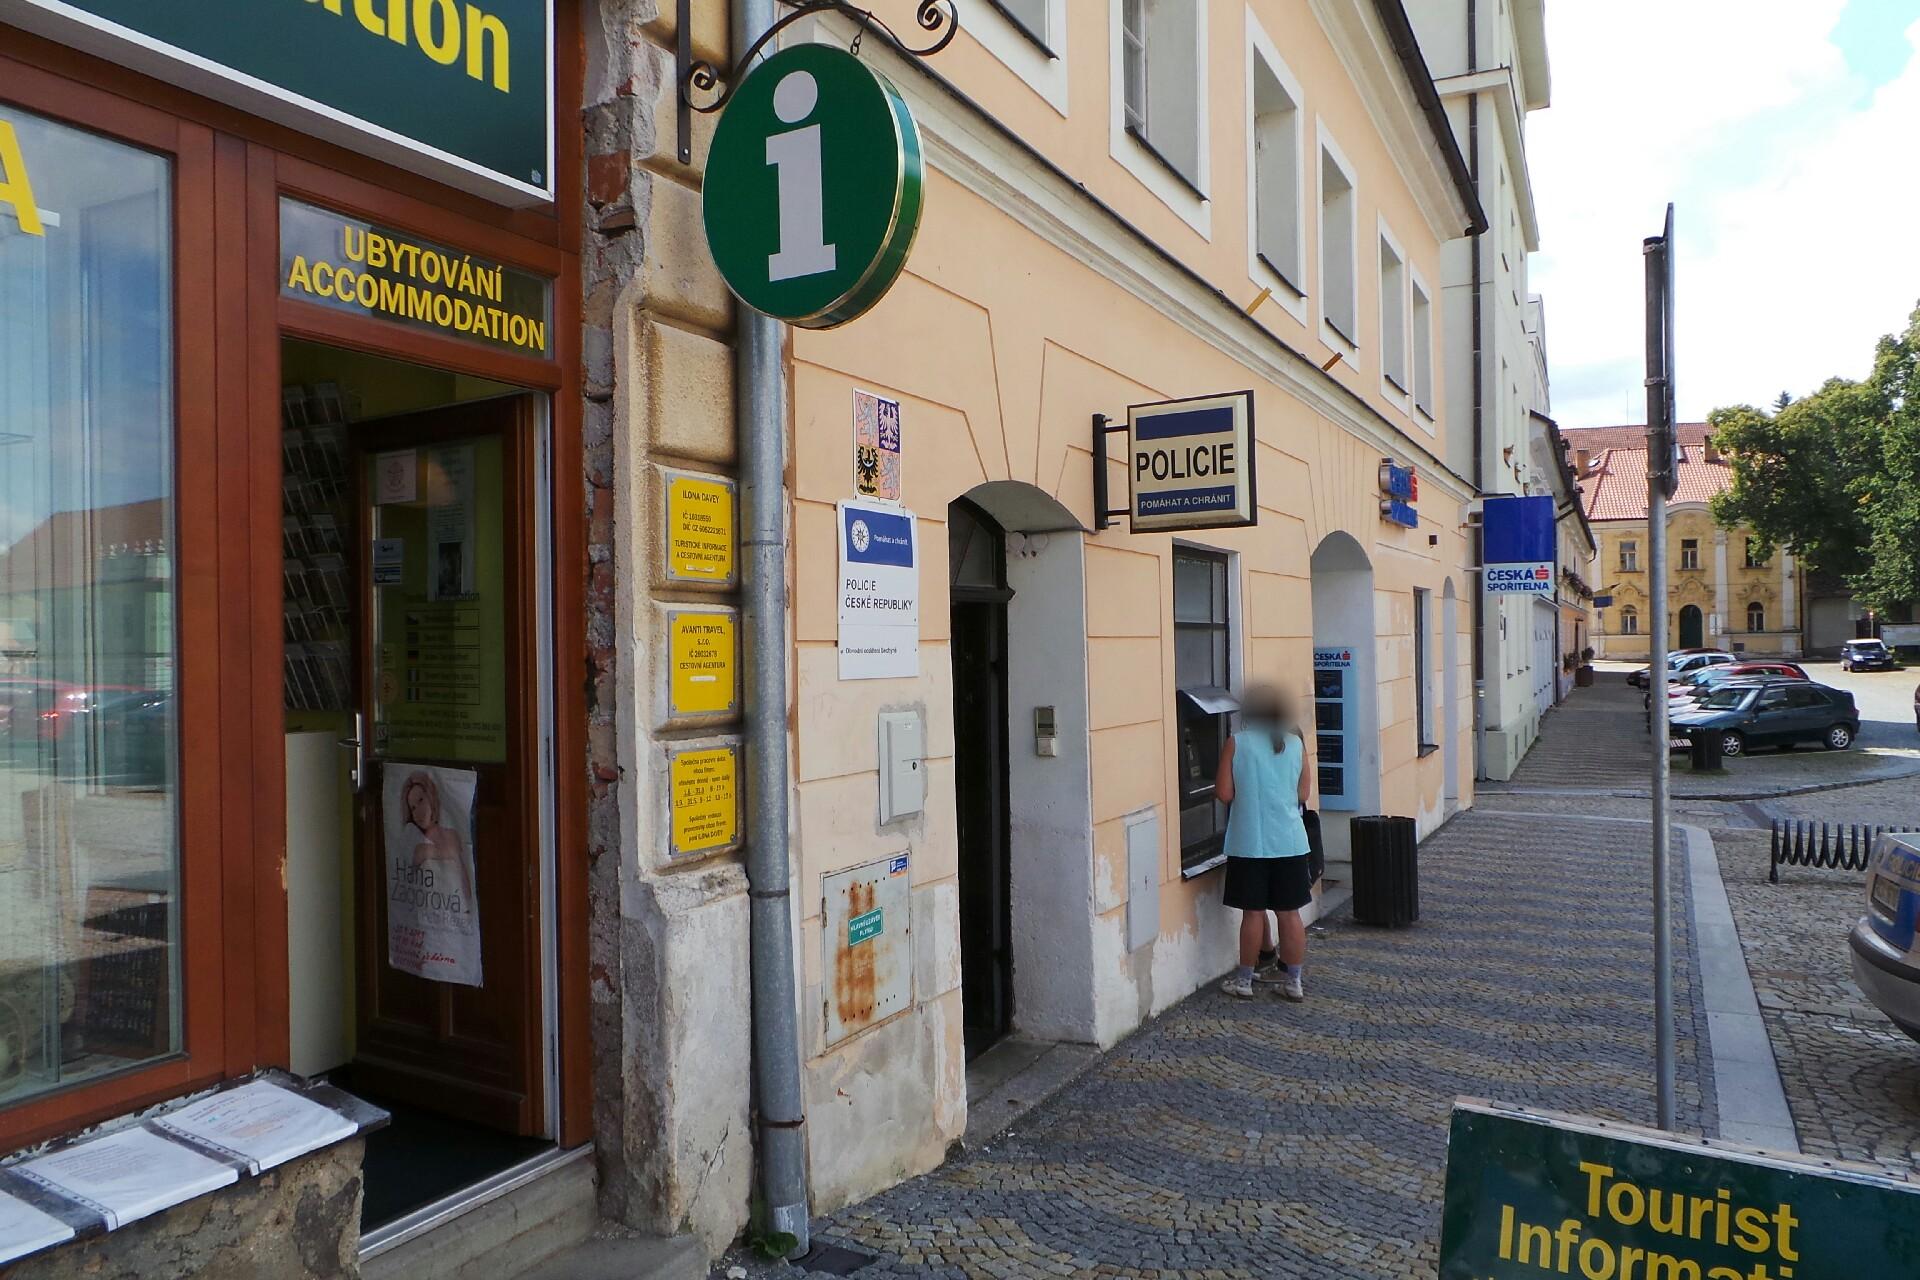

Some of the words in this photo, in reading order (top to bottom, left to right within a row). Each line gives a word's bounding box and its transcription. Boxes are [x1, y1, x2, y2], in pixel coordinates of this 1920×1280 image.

[344, 225, 503, 303] UBYTOVÁNÍ
[288, 255, 545, 351] ACCOMMODATION
[1135, 442, 1236, 482] POLICIE
[1140, 496, 1183, 510] POMÁHAT
[1183, 497, 1191, 506] A
[1191, 493, 1231, 505] CHRÁNIT
[845, 578, 877, 591] POLICIE
[1487, 567, 1535, 582] ČESKÁ
[1487, 582, 1550, 592] SPOŘITELNA
[845, 594, 872, 609] ČESKÉ
[873, 598, 913, 611] REPUBLIKY
[681, 625, 702, 634] AVANTI
[395, 857, 434, 888] Hana
[391, 877, 461, 913] Zagorová
[1579, 1160, 1799, 1262] Tourist
